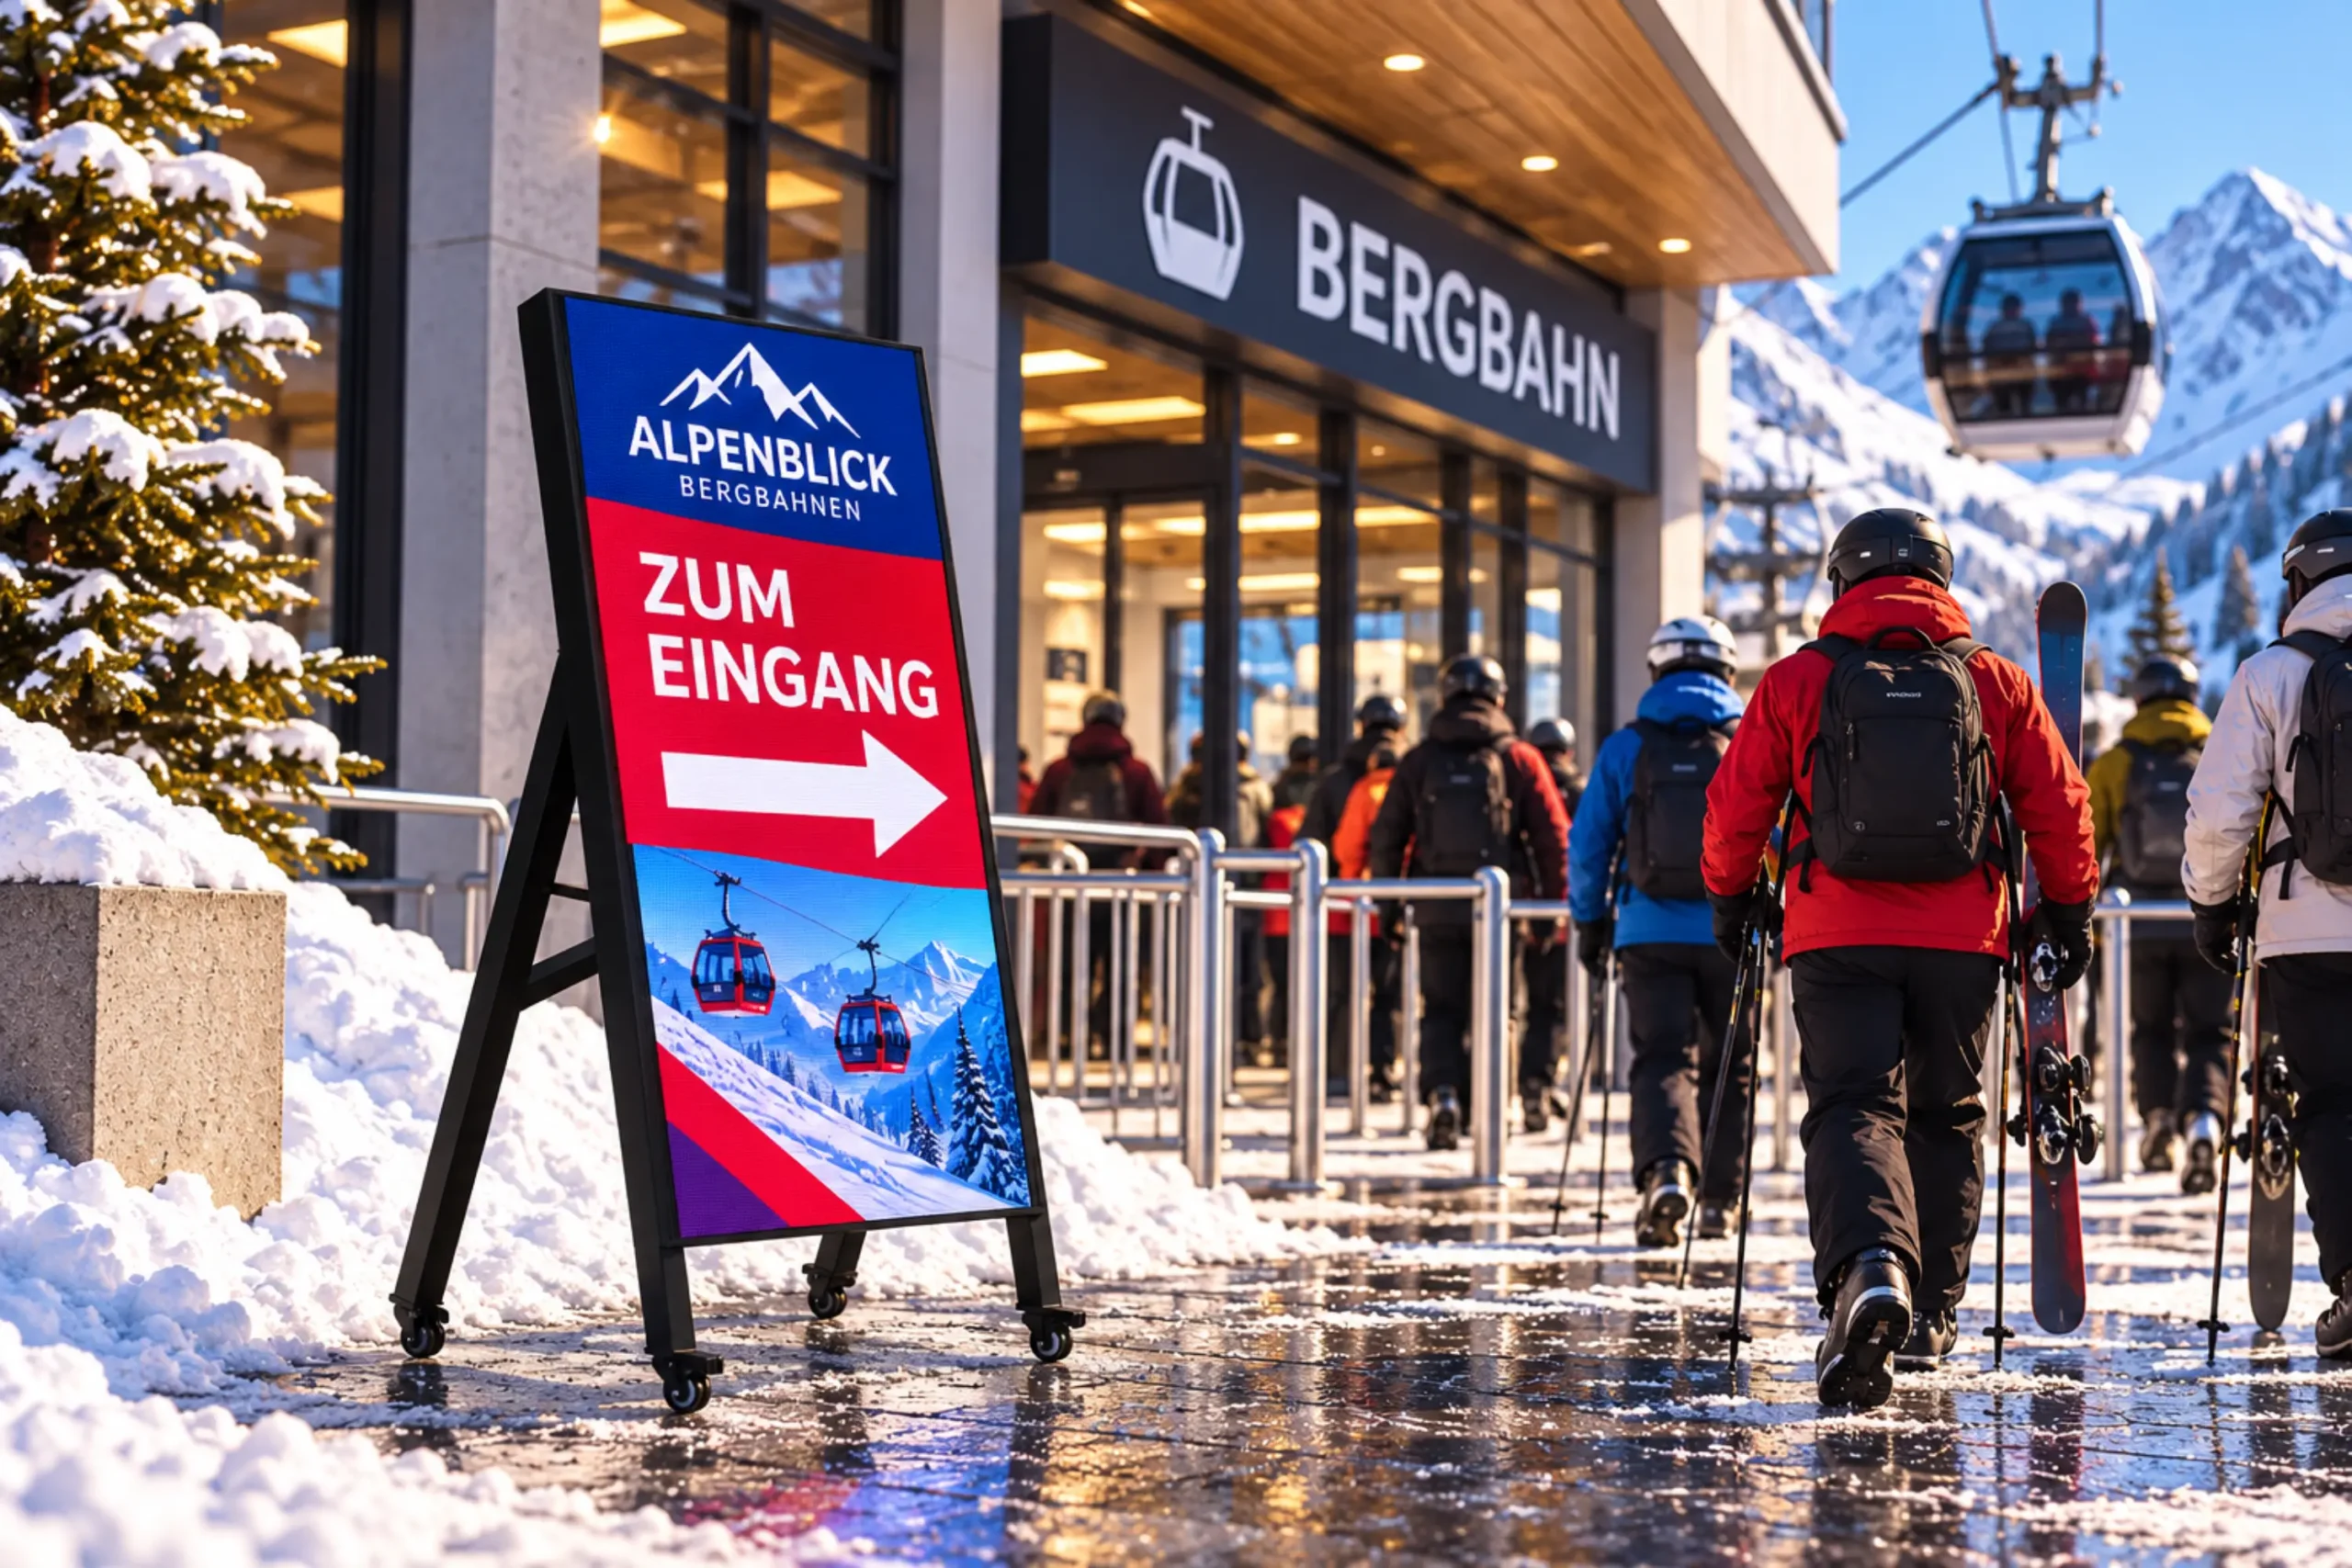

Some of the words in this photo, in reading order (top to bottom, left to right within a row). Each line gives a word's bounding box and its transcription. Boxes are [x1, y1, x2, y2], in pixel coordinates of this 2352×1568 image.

[1298, 196, 1620, 440] BERGBAHN
[628, 415, 898, 496] ALPENBLICK
[679, 474, 861, 521] BERGBAHNEN
[639, 551, 795, 628] ZUM
[648, 633, 939, 719] EINGANG
